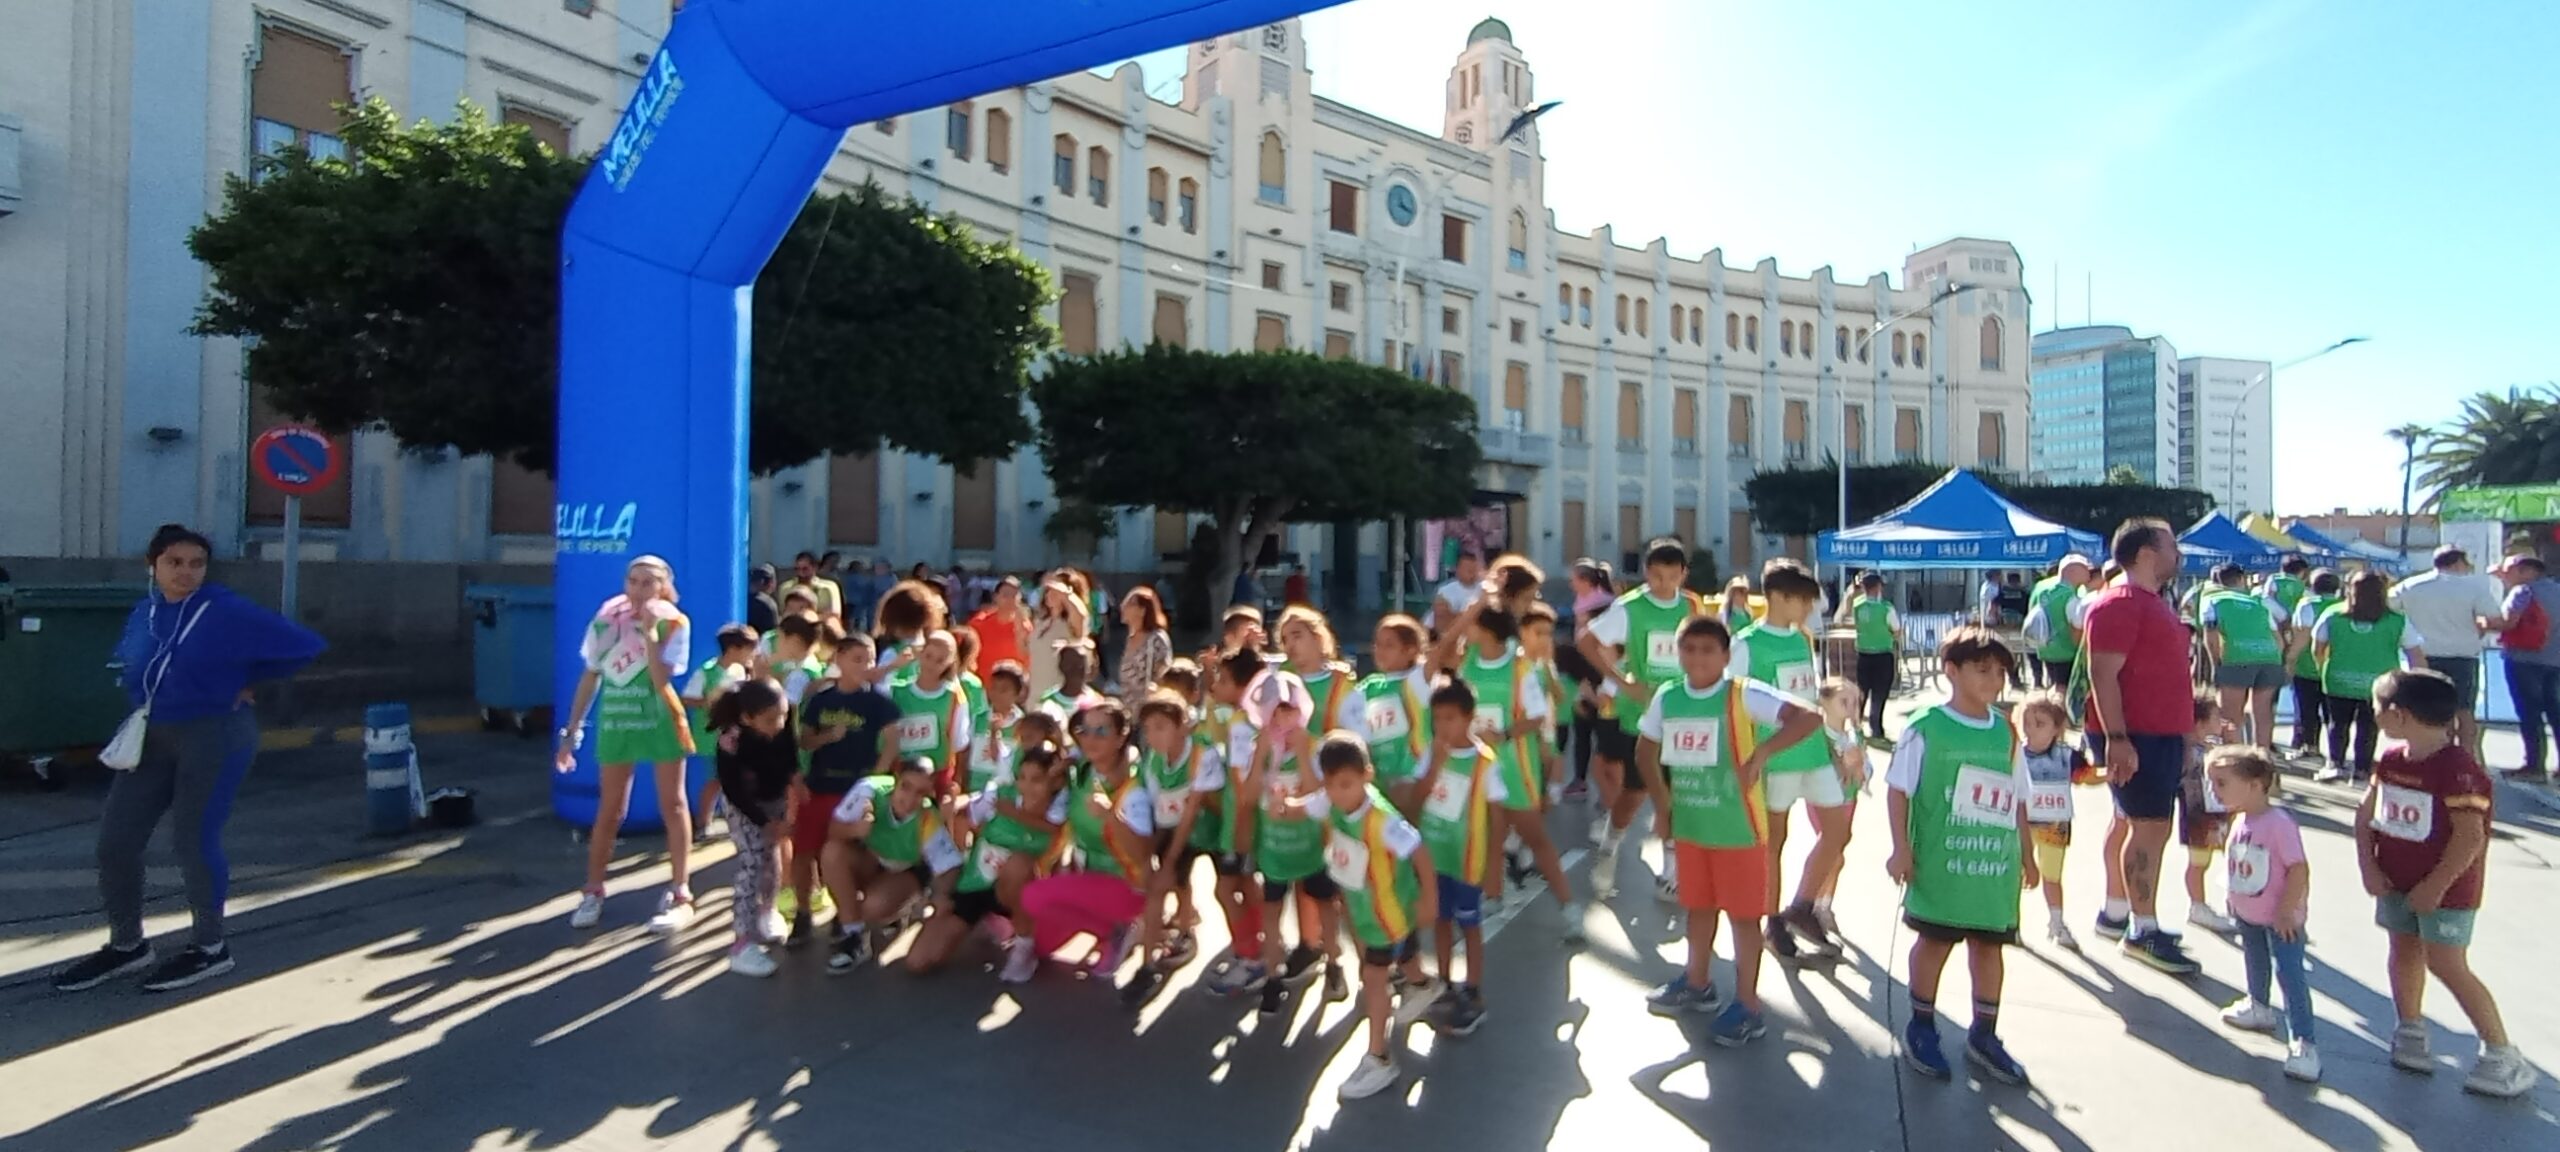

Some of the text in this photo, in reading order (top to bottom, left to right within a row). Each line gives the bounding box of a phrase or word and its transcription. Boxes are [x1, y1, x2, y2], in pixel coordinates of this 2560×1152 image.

[602, 48, 678, 184] MELILLA
[1673, 730, 1709, 751] 182
[1944, 833, 2002, 853] contra
[1946, 856, 1962, 875] el
